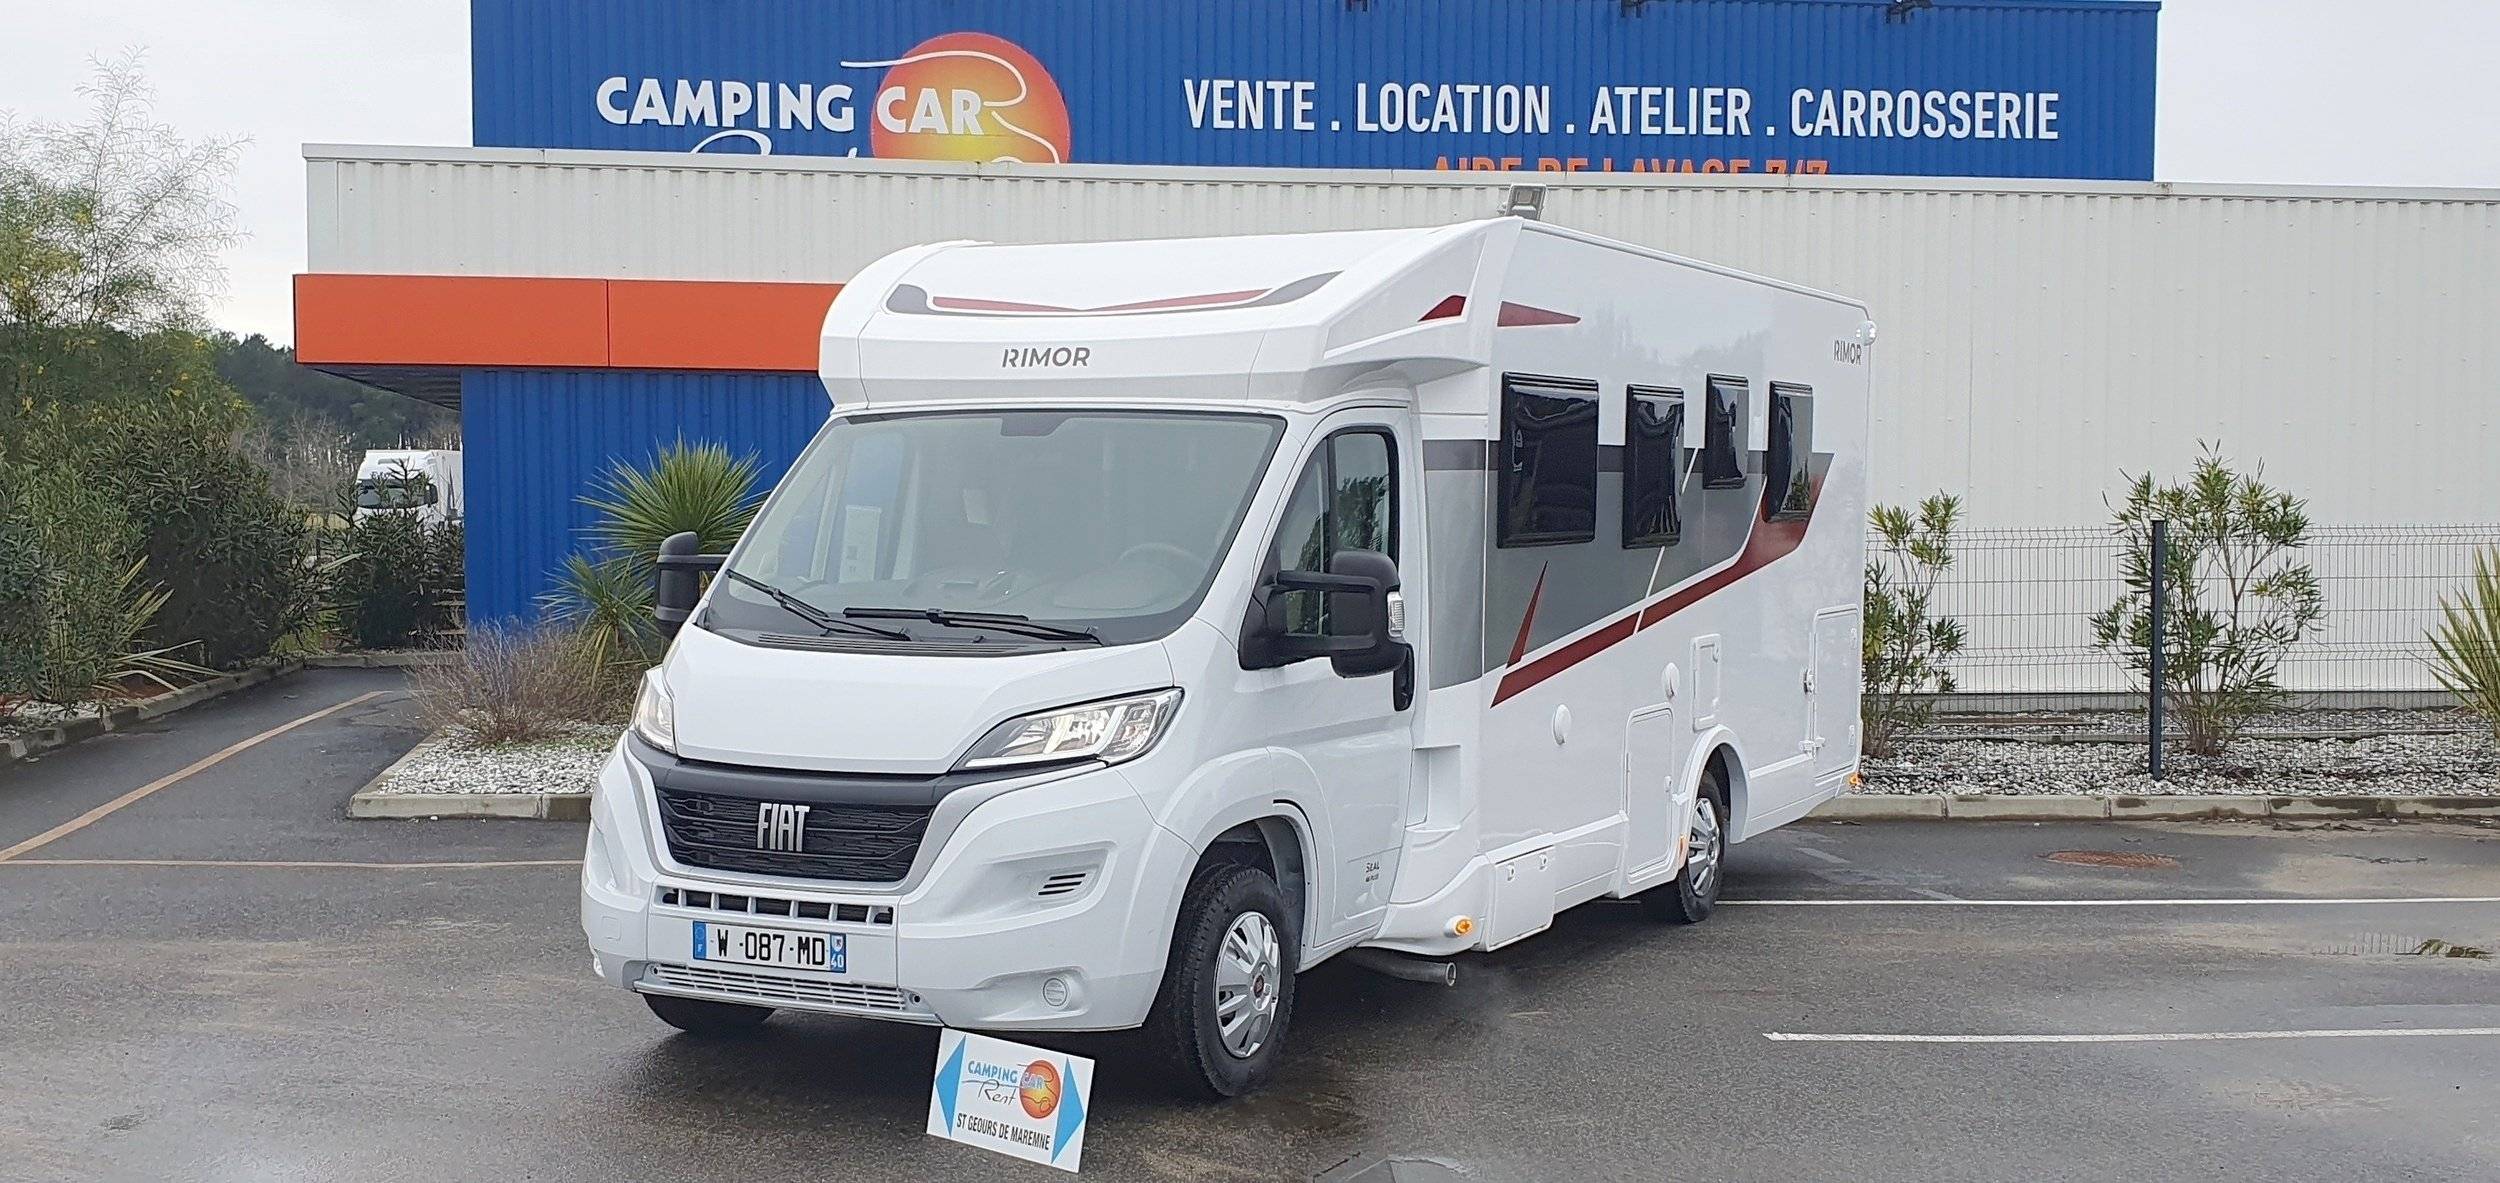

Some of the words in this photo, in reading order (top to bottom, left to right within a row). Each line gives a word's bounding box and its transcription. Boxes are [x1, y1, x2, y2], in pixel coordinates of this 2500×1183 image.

[596, 76, 855, 133] CAMPING
[876, 86, 985, 136] CAR
[1183, 79, 1315, 131] VENTE
[1357, 82, 1550, 135] LOCATION
[1590, 86, 1751, 136] ATELIER
[1791, 88, 2060, 140] CARROSSERIE
[1002, 346, 1091, 368] RIMOR
[1834, 339, 1863, 365] RIMOR
[756, 802, 810, 852] FIAT
[831, 953, 845, 969] 40
[968, 1060, 1018, 1083] CAMPING
[978, 1079, 1017, 1106] Rent
[956, 1113, 967, 1129] ST
[967, 1115, 998, 1137] GEOURS
[998, 1123, 1010, 1140] DE
[1010, 1126, 1051, 1151] MAREMNE
